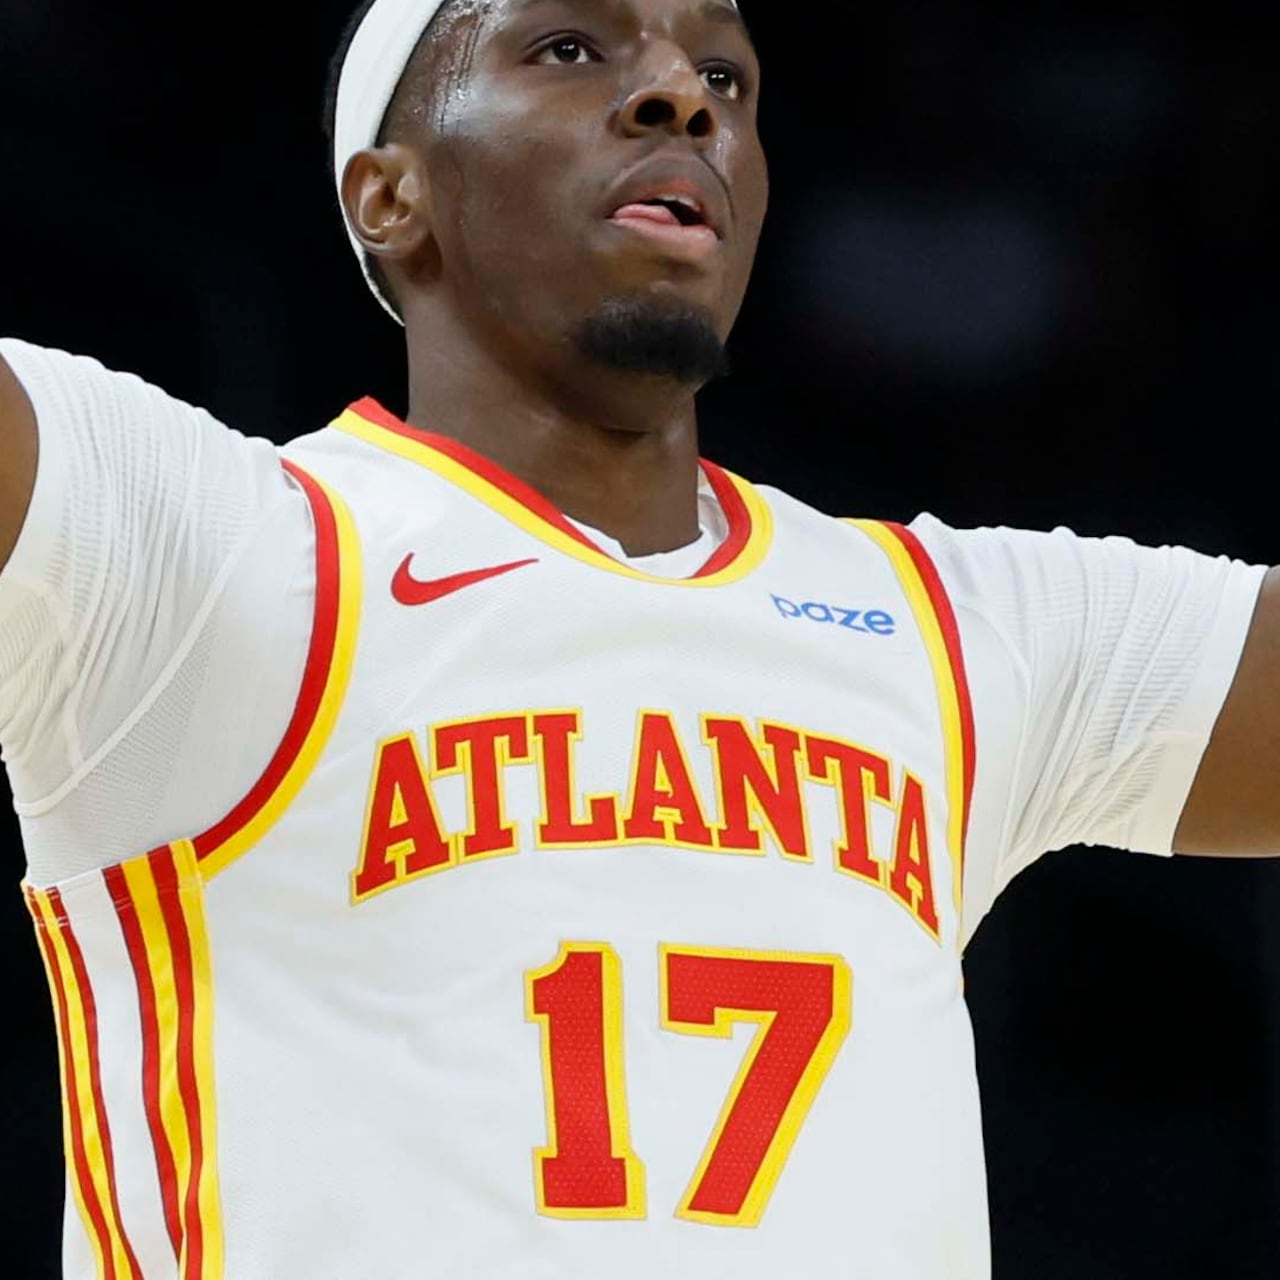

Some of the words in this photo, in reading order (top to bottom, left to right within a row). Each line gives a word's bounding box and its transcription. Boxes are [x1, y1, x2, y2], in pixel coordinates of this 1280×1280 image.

[771, 593, 895, 636] paze
[350, 707, 941, 946] ATLANTA
[524, 940, 853, 1228] 17
